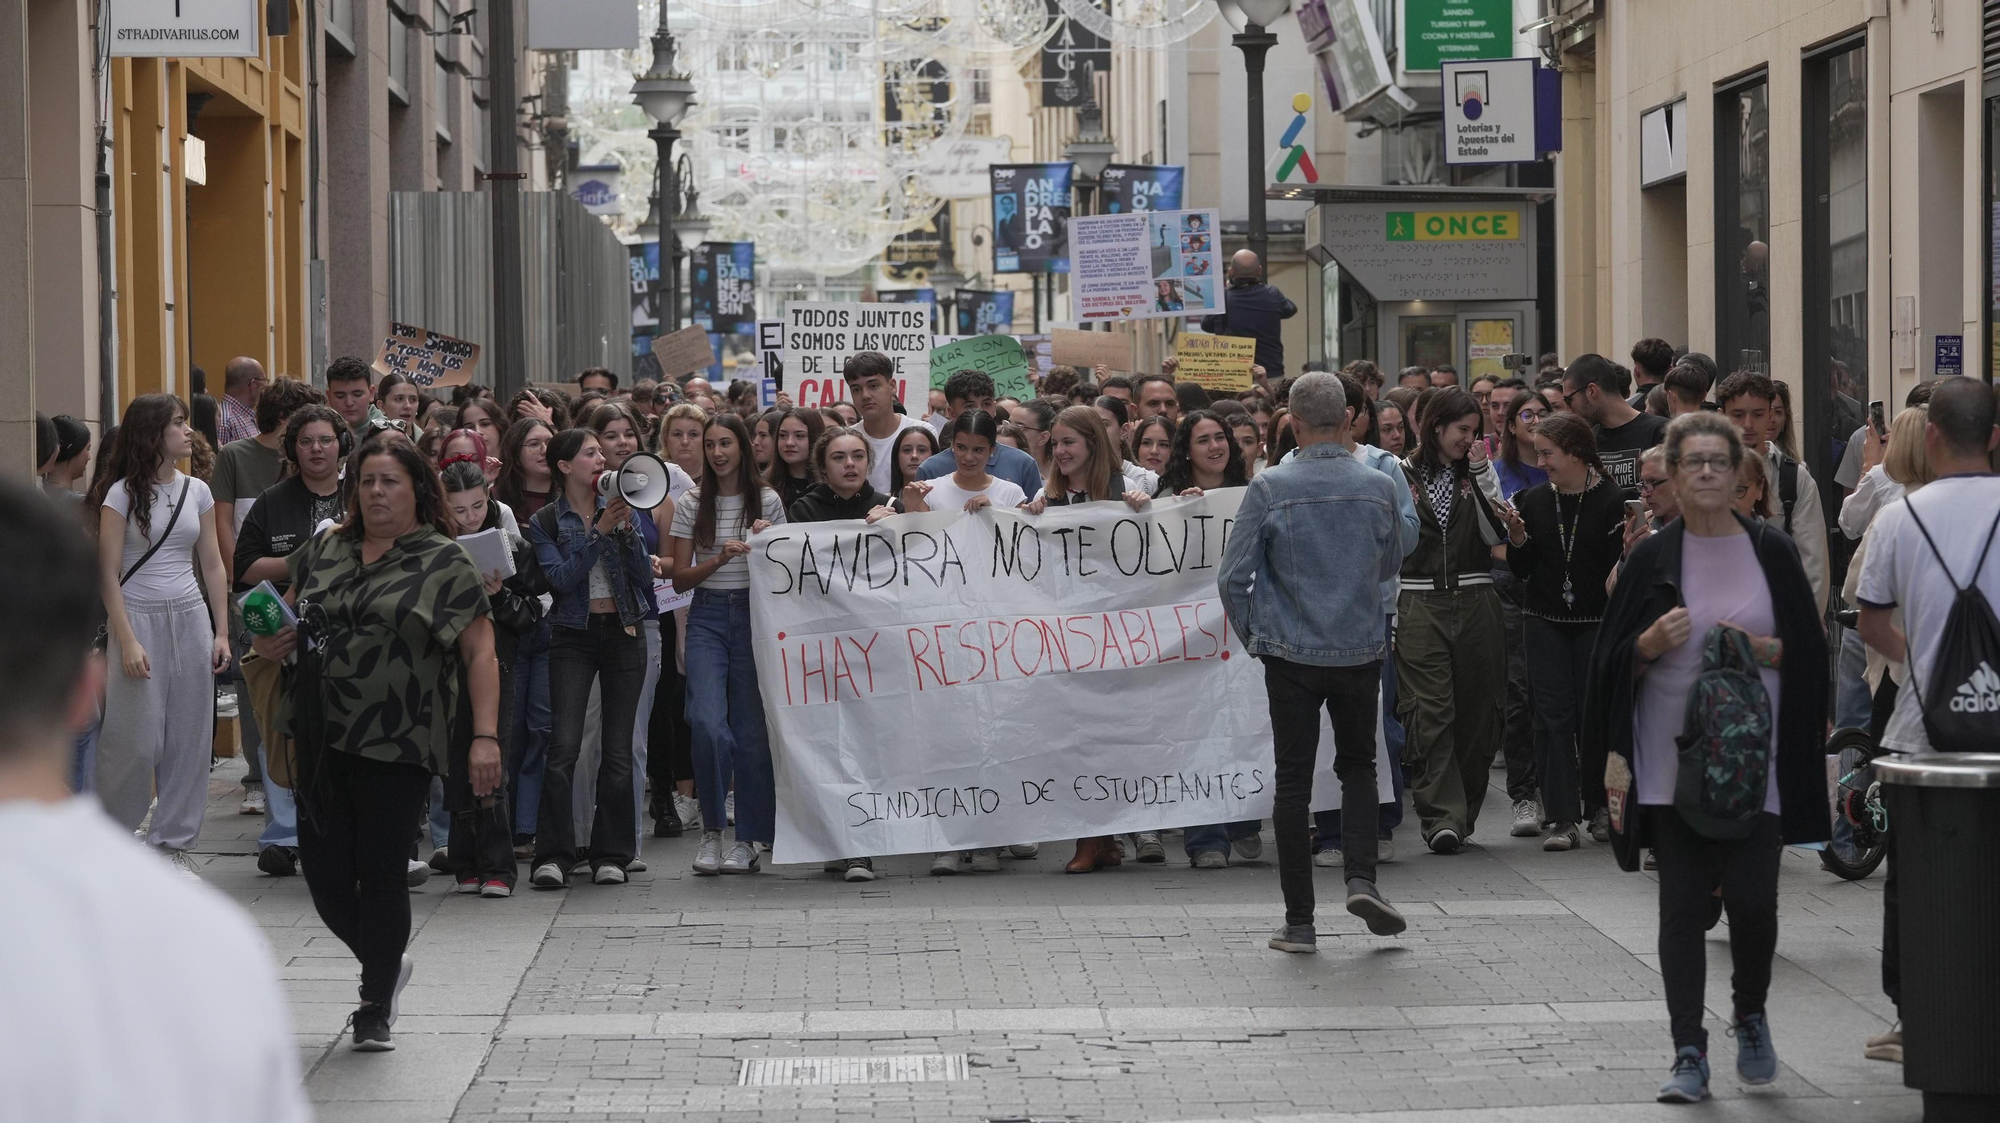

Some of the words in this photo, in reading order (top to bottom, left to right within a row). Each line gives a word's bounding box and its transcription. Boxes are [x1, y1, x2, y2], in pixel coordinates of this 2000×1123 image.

[117, 28, 240, 40] STRADIVARIUS.COM
[1457, 123, 1493, 133] Loterías
[1495, 124, 1501, 134] y
[1458, 135, 1499, 146] Apuestas
[1501, 133, 1514, 143] del
[1458, 146, 1488, 156] Estado
[994, 169, 1016, 178] OPF
[1104, 169, 1126, 178] OPF
[1024, 178, 1054, 192] AN
[1132, 180, 1164, 196] MA
[1132, 196, 1148, 209] O
[1025, 207, 1053, 220] PA
[1026, 220, 1053, 234] LA
[1426, 215, 1508, 236] ONCE
[1026, 235, 1042, 249] O
[716, 254, 735, 266] EL
[632, 268, 660, 280] QIA
[717, 267, 750, 279] DAR
[718, 279, 739, 291] NE
[718, 303, 744, 315] SIN
[792, 309, 849, 327] TODOS
[856, 310, 924, 328] JUNTOS
[391, 322, 417, 338] POR
[425, 331, 473, 358] SANDRA
[791, 332, 845, 350] SOMOS
[854, 333, 878, 350] LAS
[882, 333, 925, 351] VOCES
[973, 339, 1003, 353] CON
[384, 354, 409, 368] QUE
[385, 338, 397, 351] Y
[398, 345, 433, 359] TODOS
[441, 355, 463, 370] LOS
[802, 356, 823, 373] DE
[993, 376, 1025, 396] DAS
[1615, 462, 1633, 474] RIDE
[1616, 474, 1633, 486] LIVE
[766, 528, 966, 595] SANDRA
[992, 522, 1041, 581] NO
[1052, 525, 1098, 576] TE
[778, 631, 879, 706] ¡HAY
[907, 602, 1231, 691] RESPONSABLES!
[1949, 692, 2000, 713] adid
[847, 786, 1000, 827] SINDICATO
[1022, 779, 1055, 805] DE
[1074, 769, 1264, 808] ESTUDIANTES
